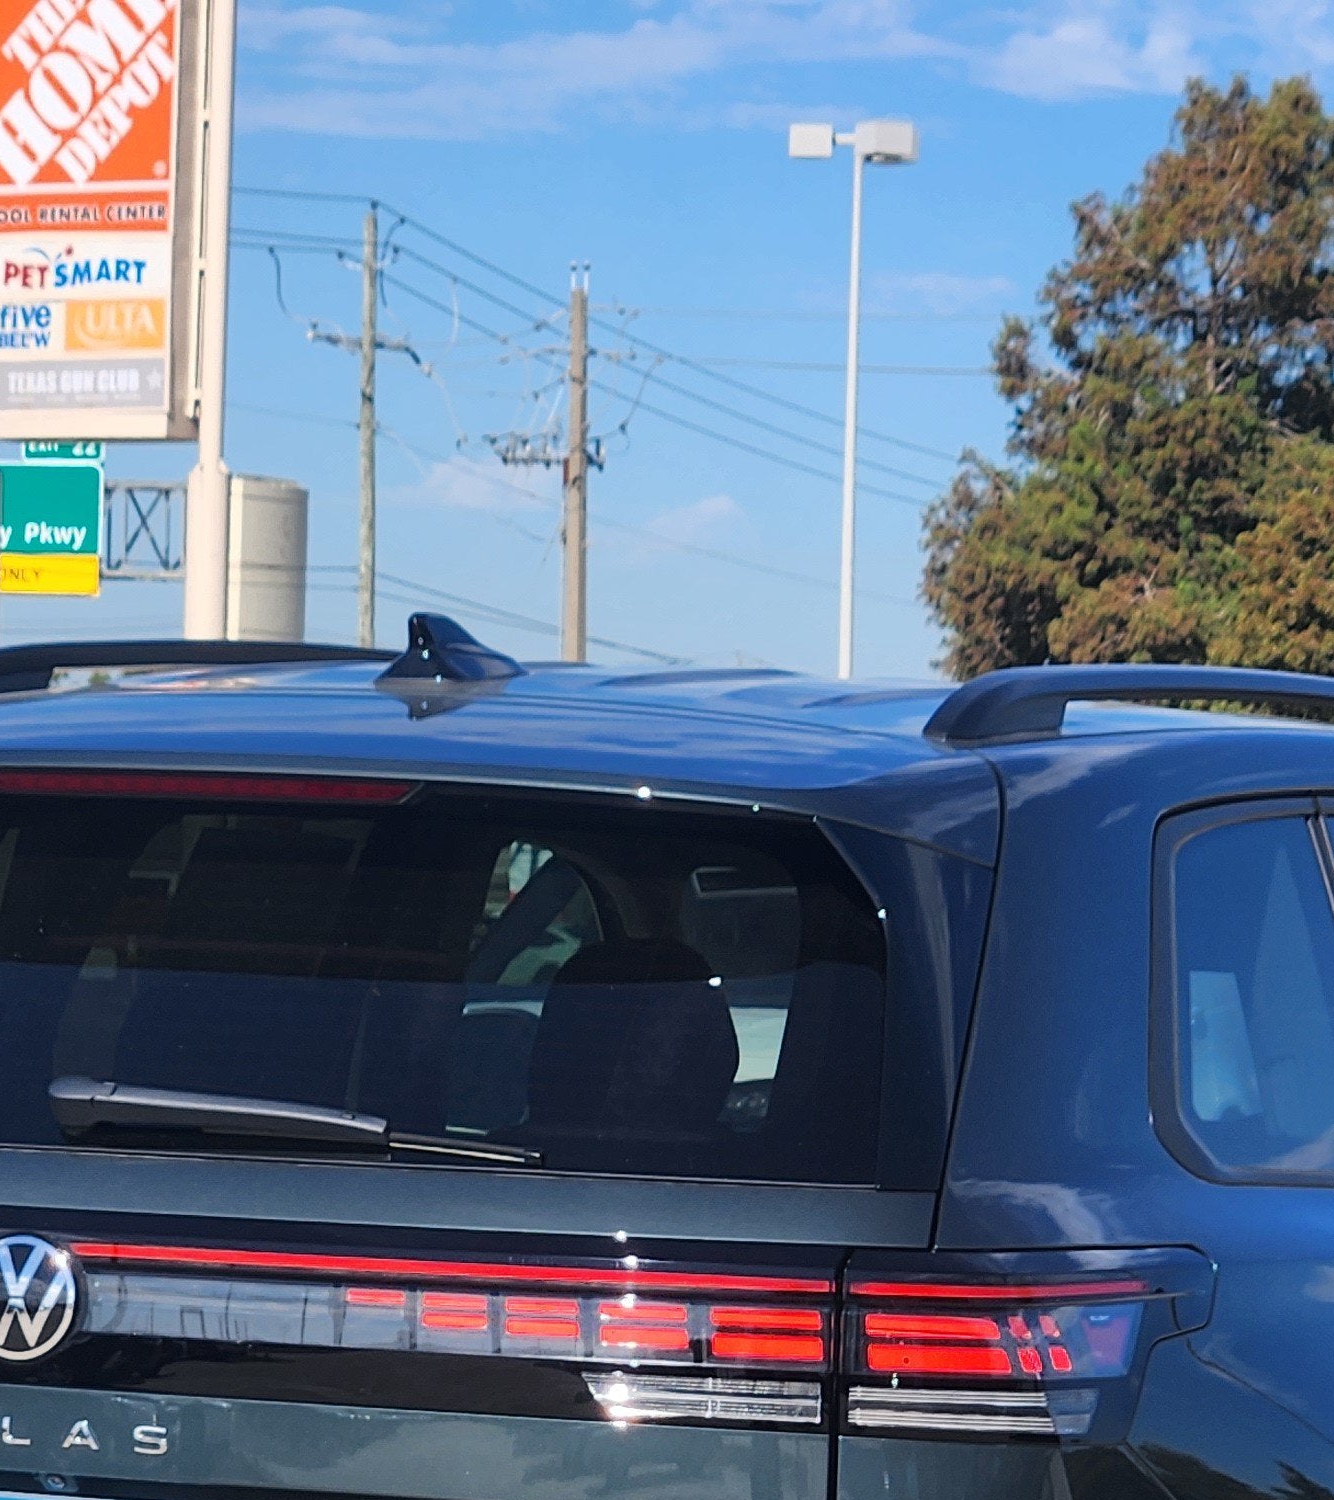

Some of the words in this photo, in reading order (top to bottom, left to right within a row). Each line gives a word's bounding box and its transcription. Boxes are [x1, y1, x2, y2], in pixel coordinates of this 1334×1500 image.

[54, 30, 173, 183] DEPOT
[39, 206, 99, 221] RENTAL
[106, 204, 166, 220] CENTER
[0, 304, 51, 328] five
[85, 303, 158, 335] ULTA
[24, 521, 87, 551] Pkwy
